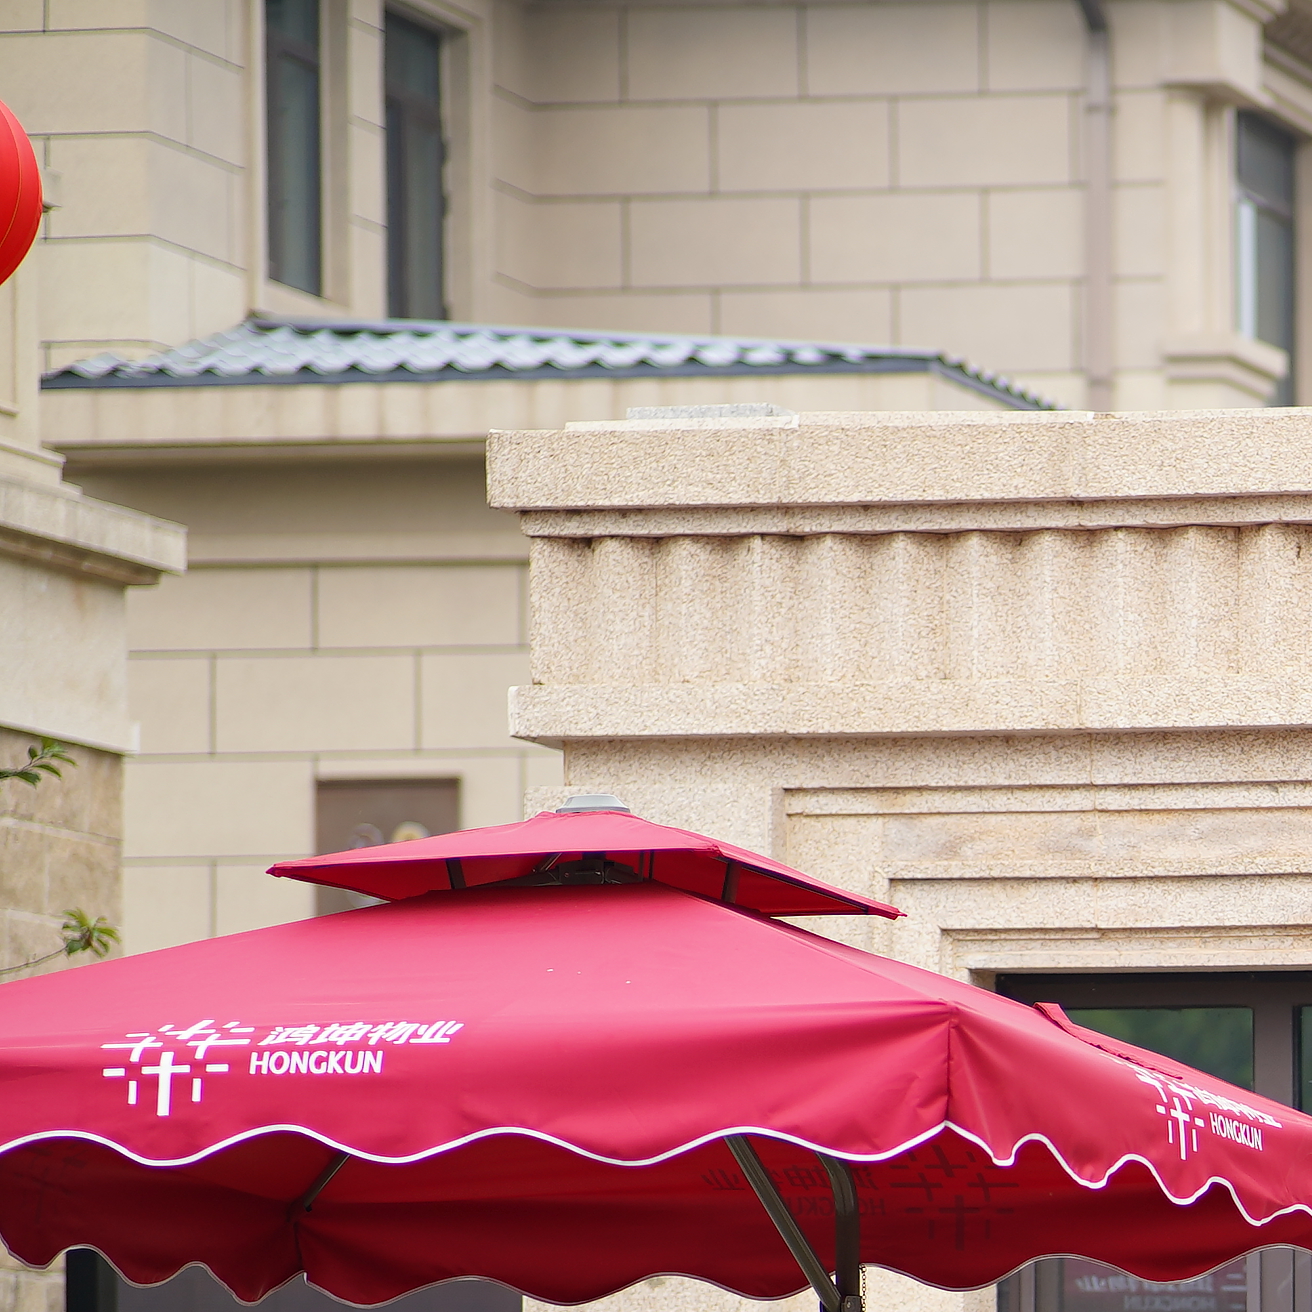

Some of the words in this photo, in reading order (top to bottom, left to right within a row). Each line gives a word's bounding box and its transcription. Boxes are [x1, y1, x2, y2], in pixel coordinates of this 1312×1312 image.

[257, 1021, 464, 1046] 鸿坤物业
[249, 1050, 383, 1075] HONGKUN
[1209, 1111, 1263, 1151] HONGKUN
